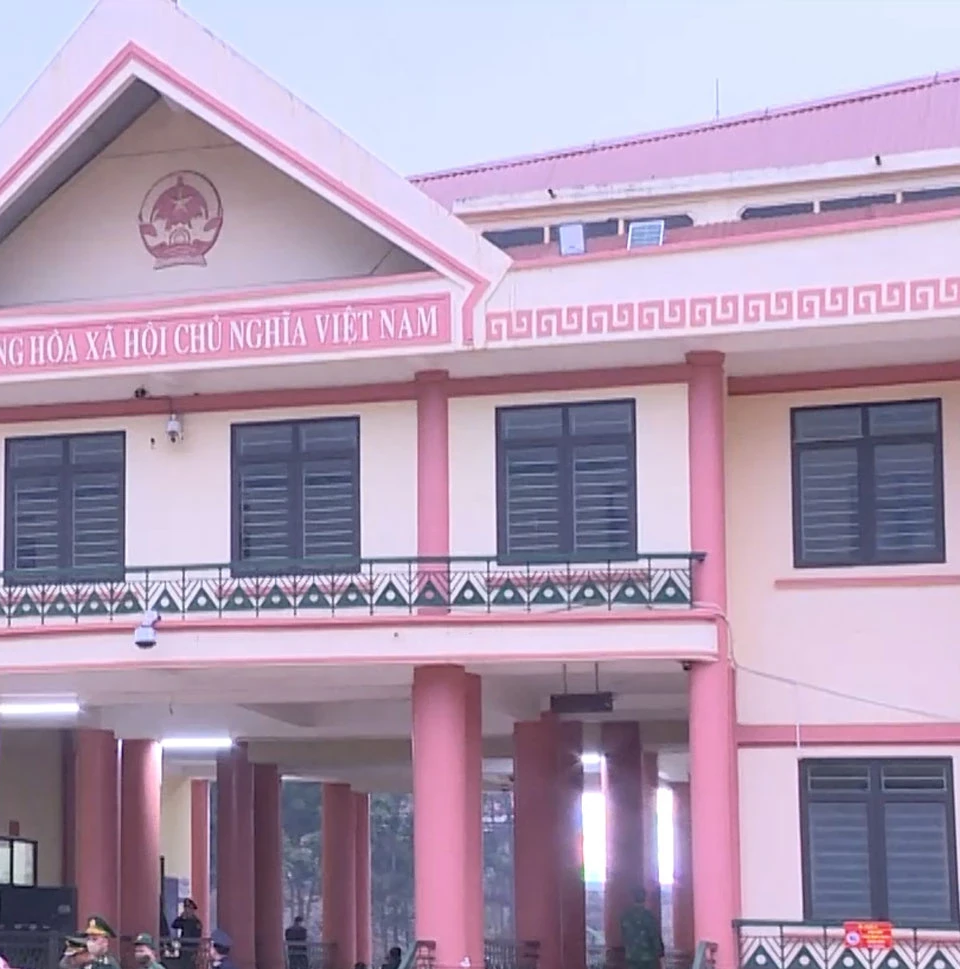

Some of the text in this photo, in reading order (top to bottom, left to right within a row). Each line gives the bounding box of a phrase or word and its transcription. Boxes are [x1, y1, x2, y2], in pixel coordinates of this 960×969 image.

[29, 328, 79, 366] HÒA
[84, 324, 117, 360] XÃ
[124, 321, 167, 360] HỘI
[174, 314, 222, 354] CHỦ
[229, 311, 307, 351] NGHĨA
[315, 305, 373, 344] VIỆT
[379, 305, 439, 339] NAM
